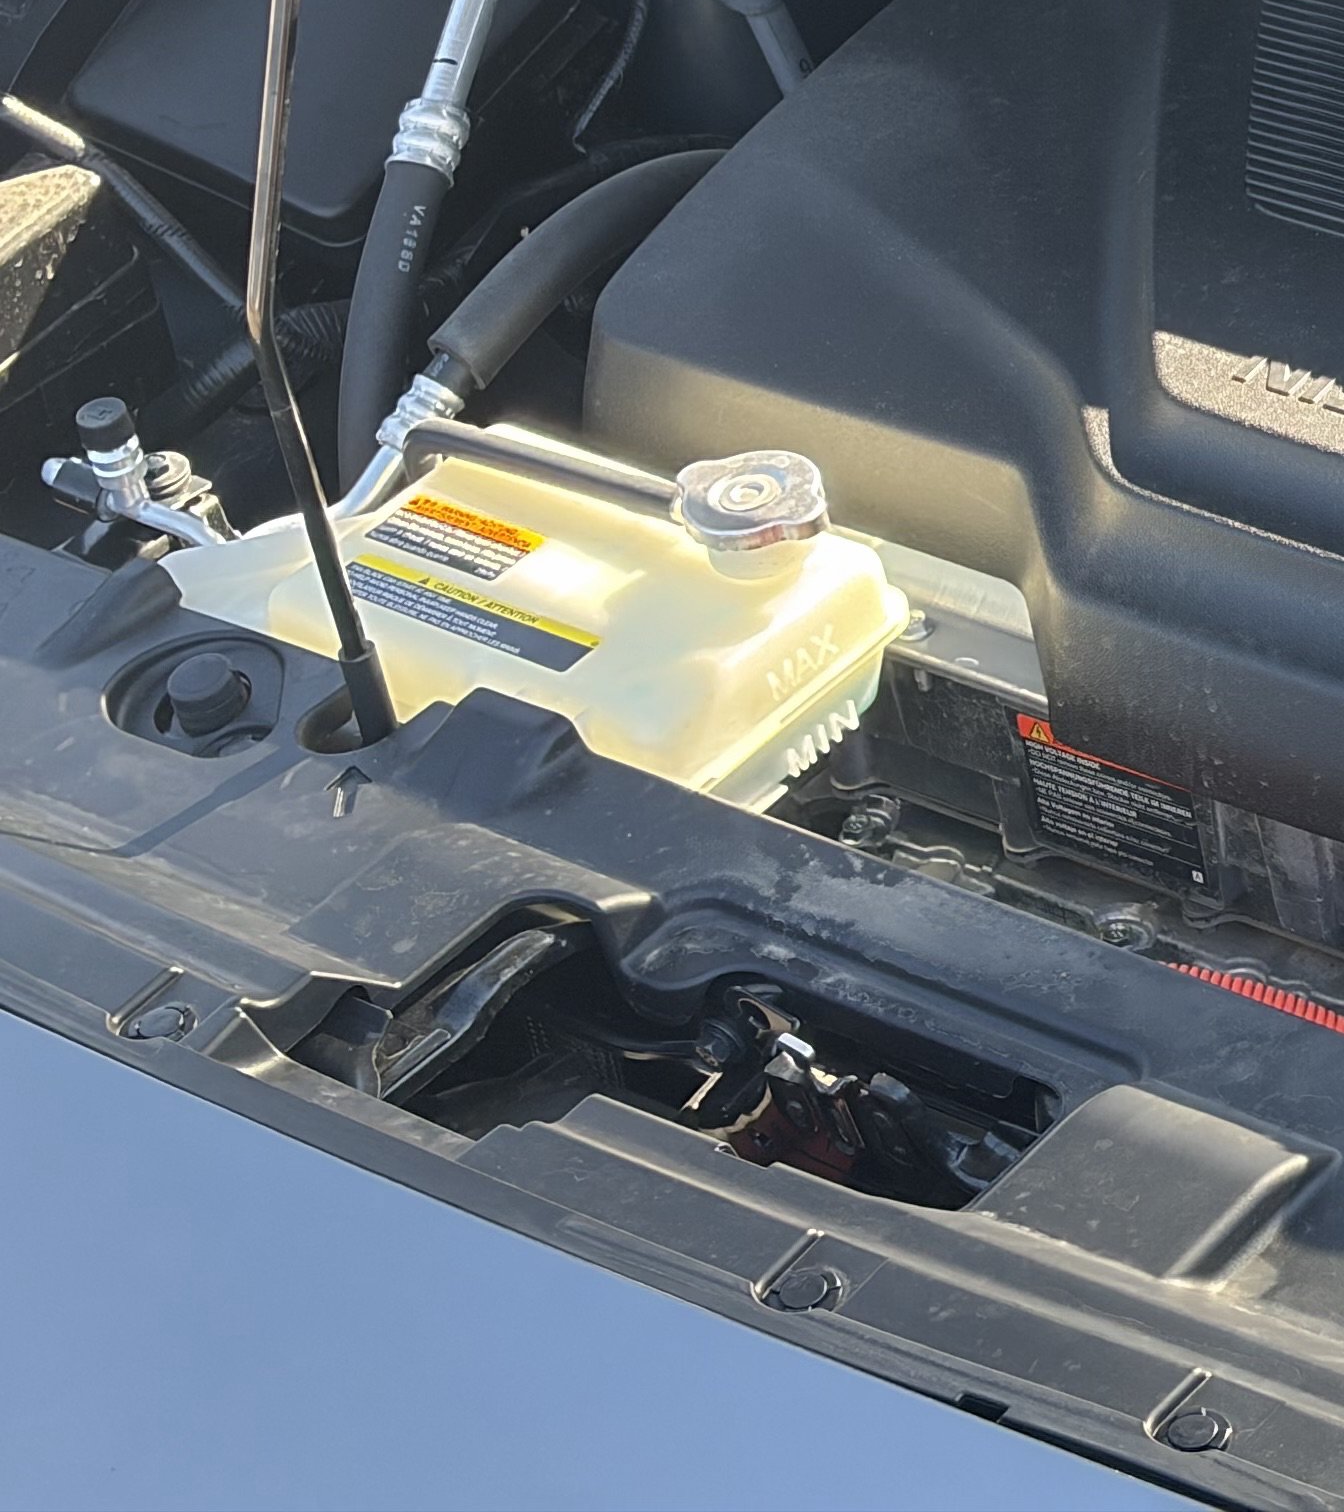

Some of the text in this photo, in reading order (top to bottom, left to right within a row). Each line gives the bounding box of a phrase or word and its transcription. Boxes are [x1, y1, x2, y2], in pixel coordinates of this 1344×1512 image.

[434, 582, 477, 604] CAUTION
[486, 600, 539, 625] ATTENTION
[766, 623, 840, 702] MAX
[786, 699, 860, 778] MIN
